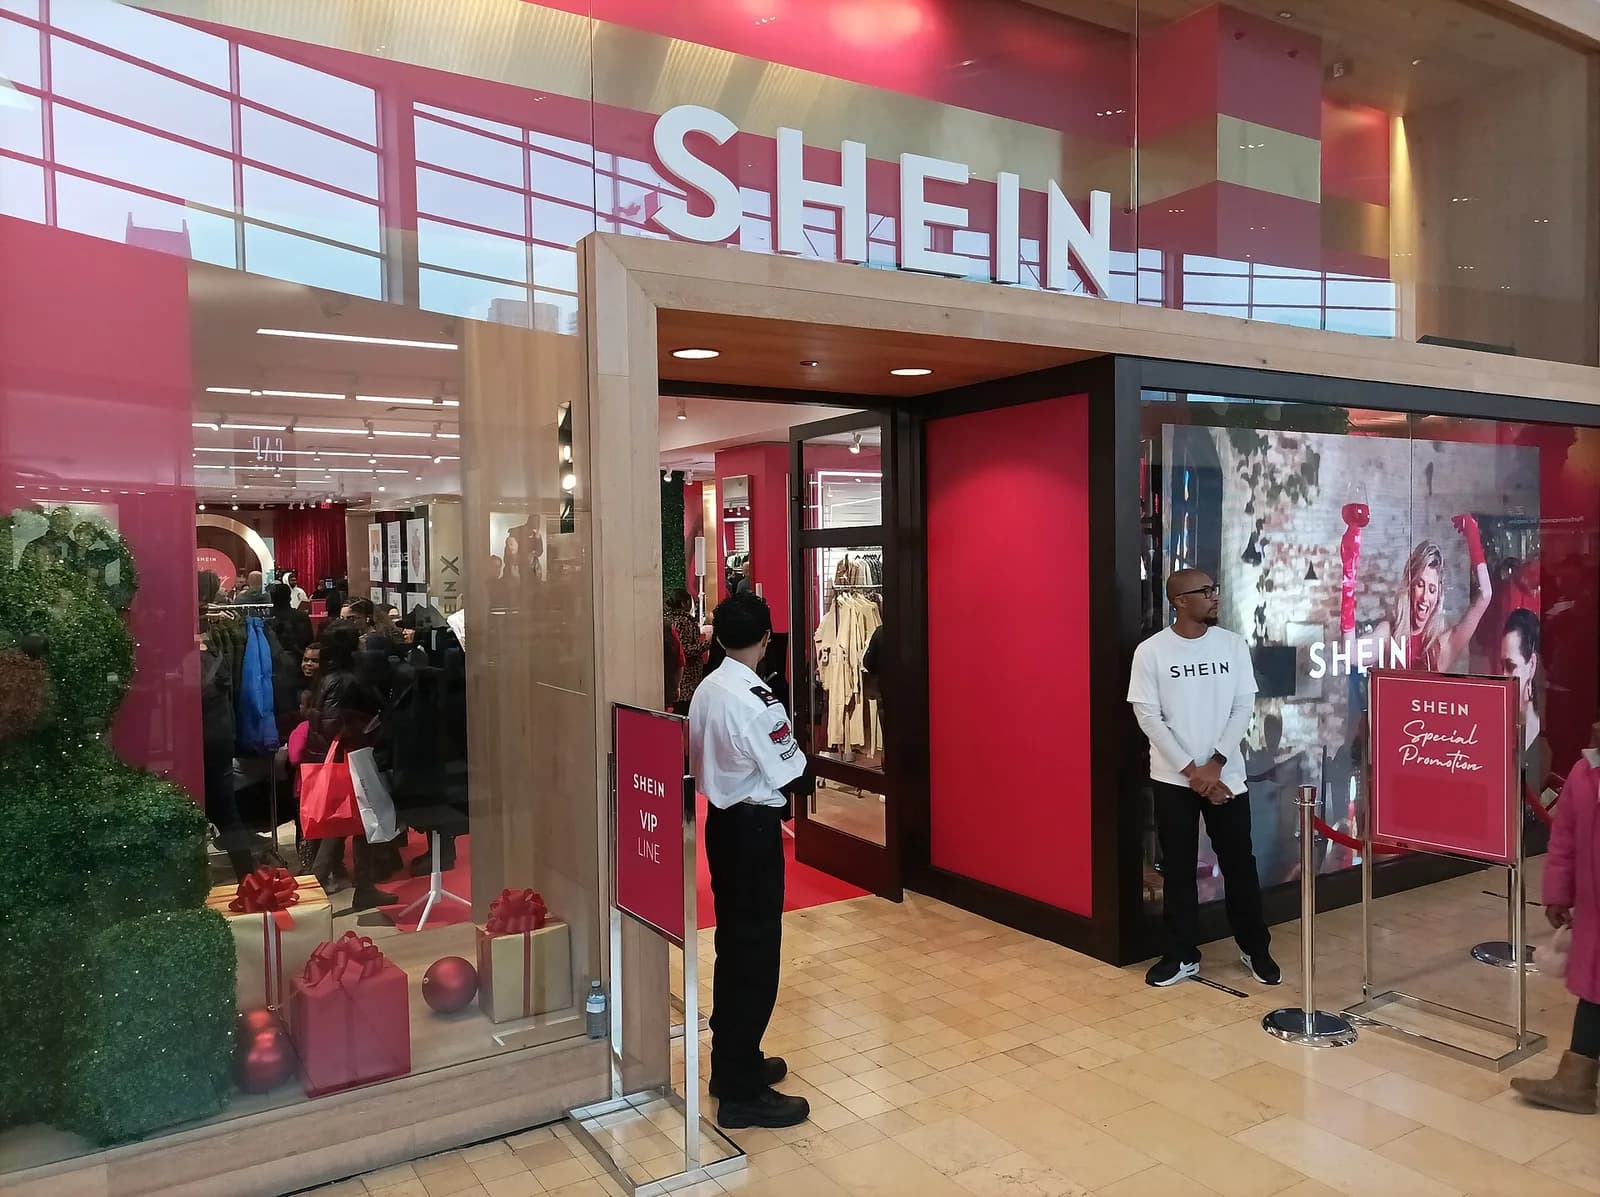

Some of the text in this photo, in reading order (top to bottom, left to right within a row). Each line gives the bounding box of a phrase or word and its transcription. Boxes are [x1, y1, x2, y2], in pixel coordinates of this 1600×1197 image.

[653, 105, 1111, 300] SHEIN
[439, 555, 460, 576] X
[1309, 635, 1407, 679] SHEIN
[1170, 662, 1230, 679] SHEIN
[1411, 699, 1469, 716] SHEIN
[1403, 720, 1478, 747] Special
[1398, 744, 1483, 774] Promotion
[633, 773, 665, 798] SHEIN
[640, 809, 658, 833] VIP
[638, 837, 661, 864] LINE
